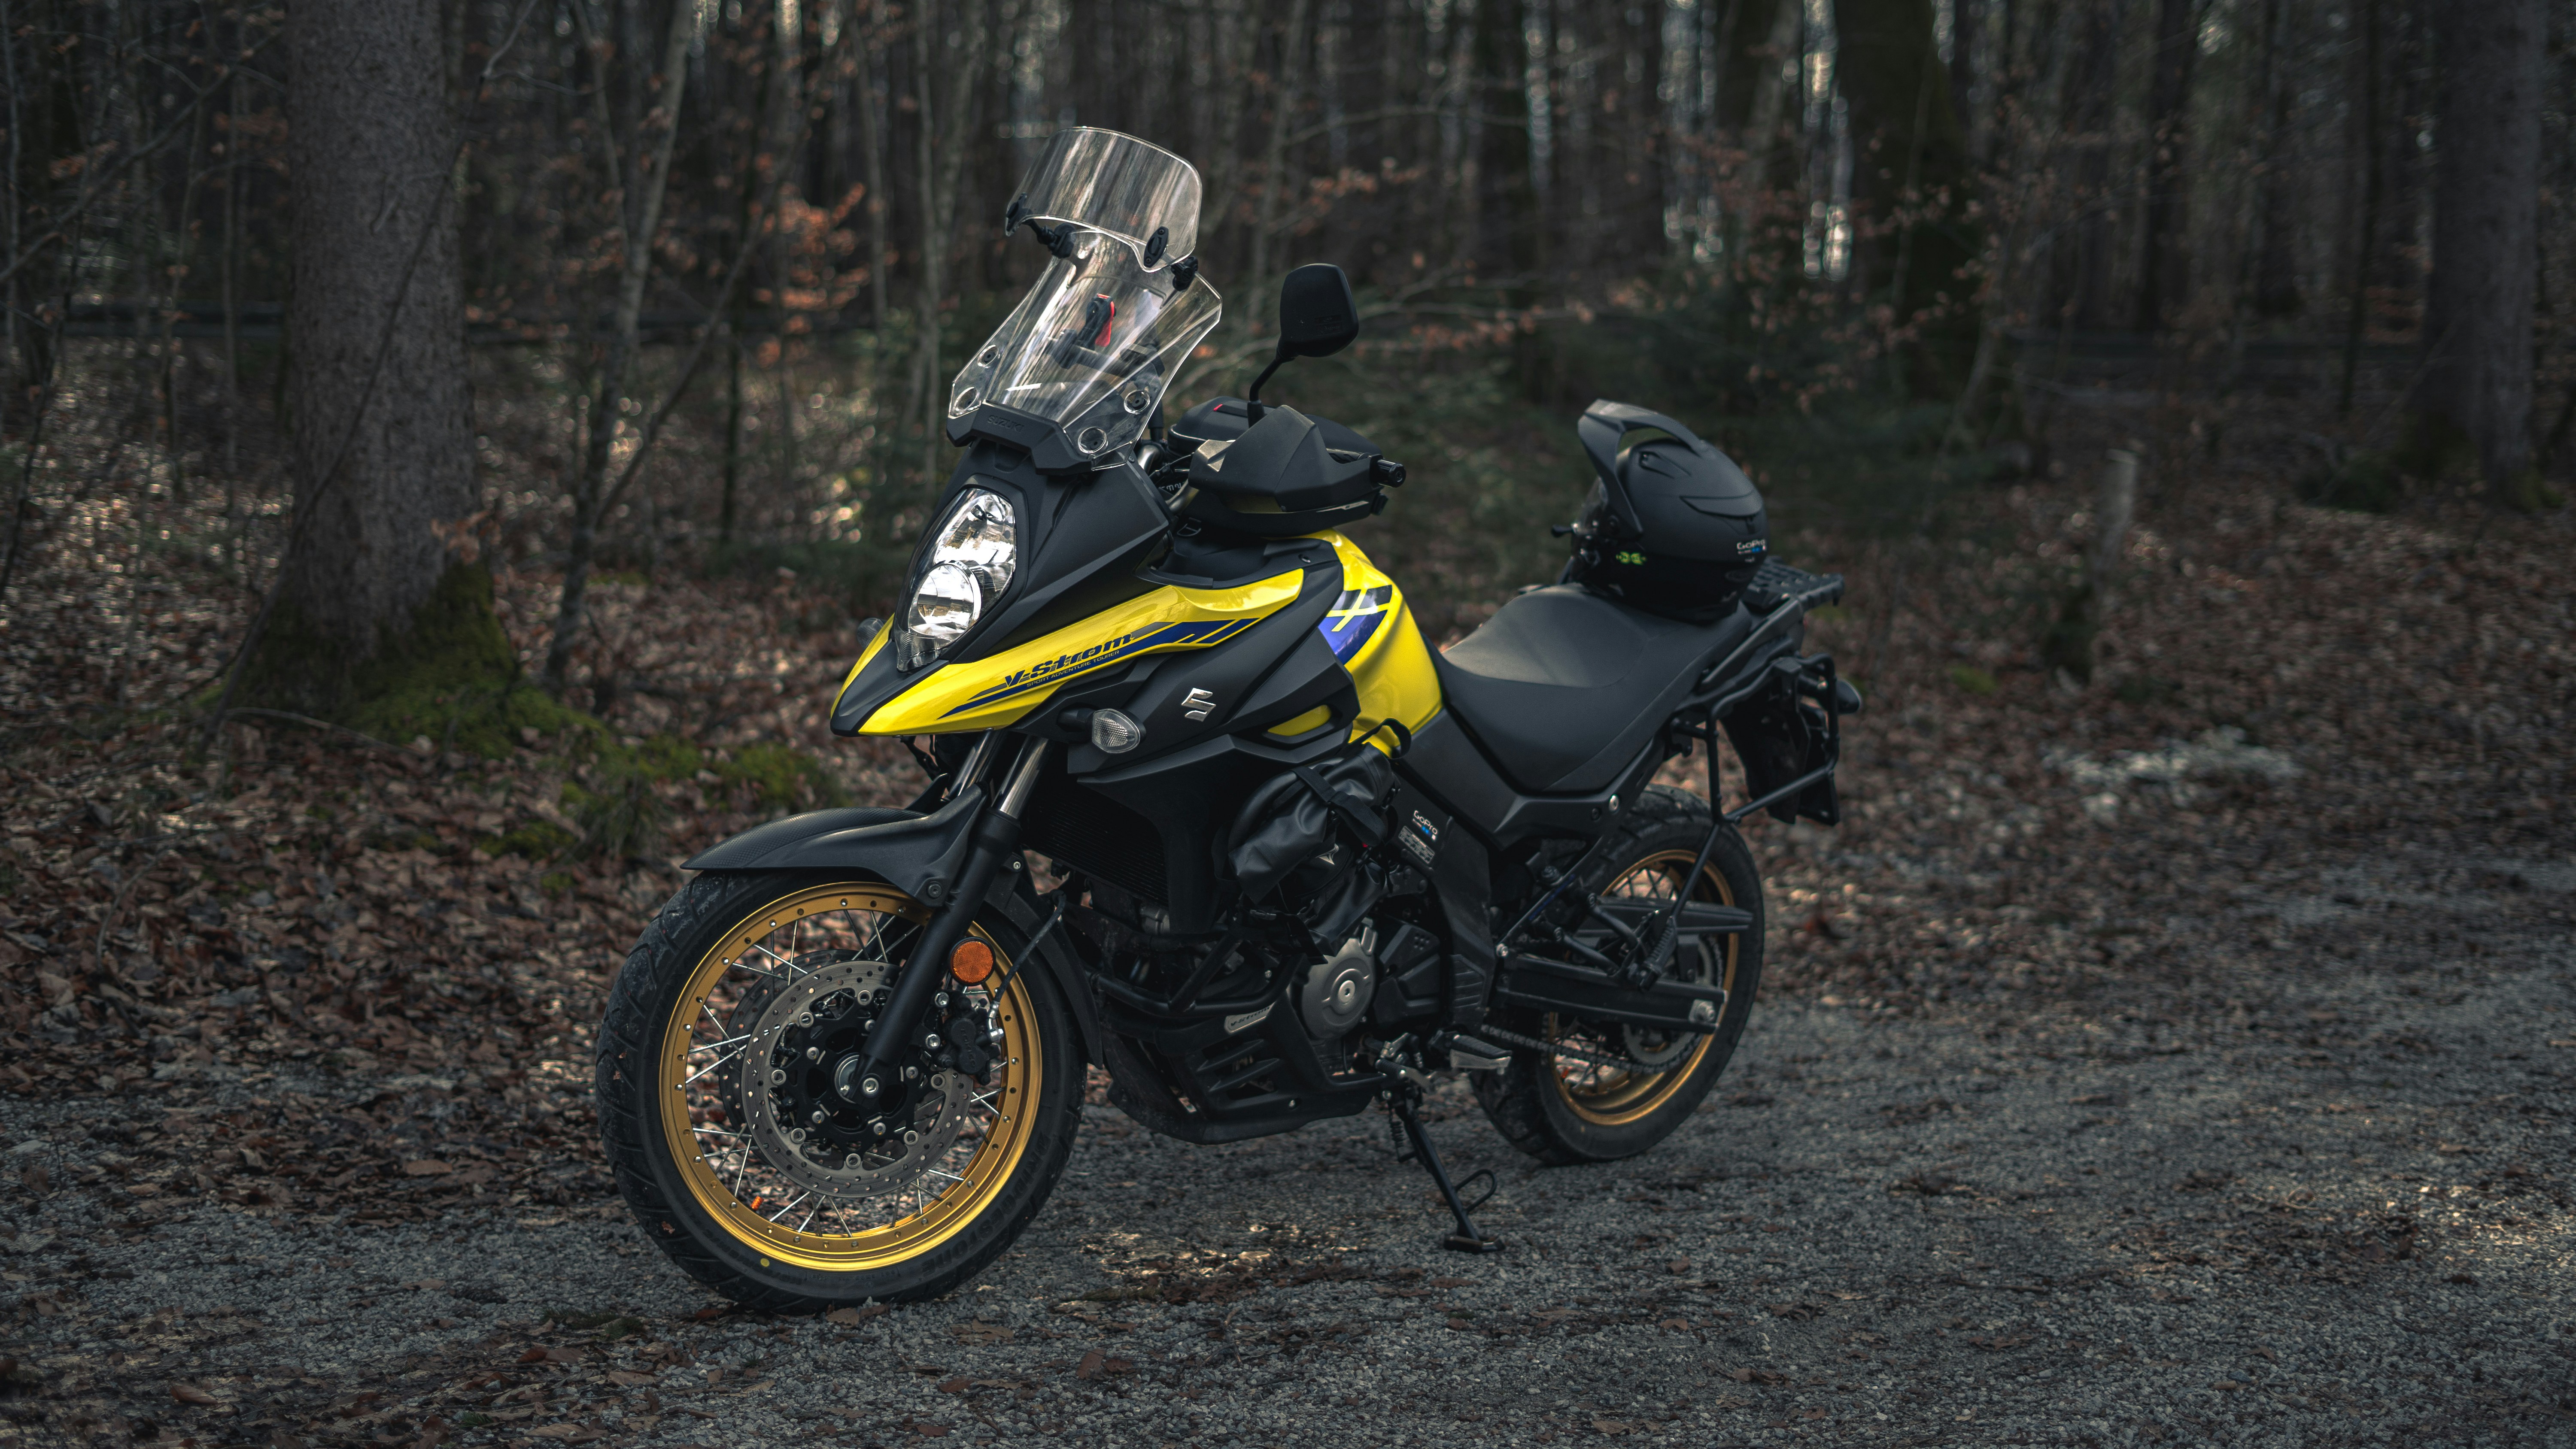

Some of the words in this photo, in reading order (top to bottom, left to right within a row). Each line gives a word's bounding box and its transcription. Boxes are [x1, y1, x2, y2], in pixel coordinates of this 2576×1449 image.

[987, 415, 1025, 433] SUZUKI
[1005, 634, 1133, 687] V-Strom
[1027, 677, 1048, 687] SPORT
[1051, 661, 1091, 679] ADVENTURE
[1093, 650, 1120, 662] TOURER
[1413, 810, 1438, 835] GoPro
[919, 1131, 1054, 1278] BRIDGESTONE
